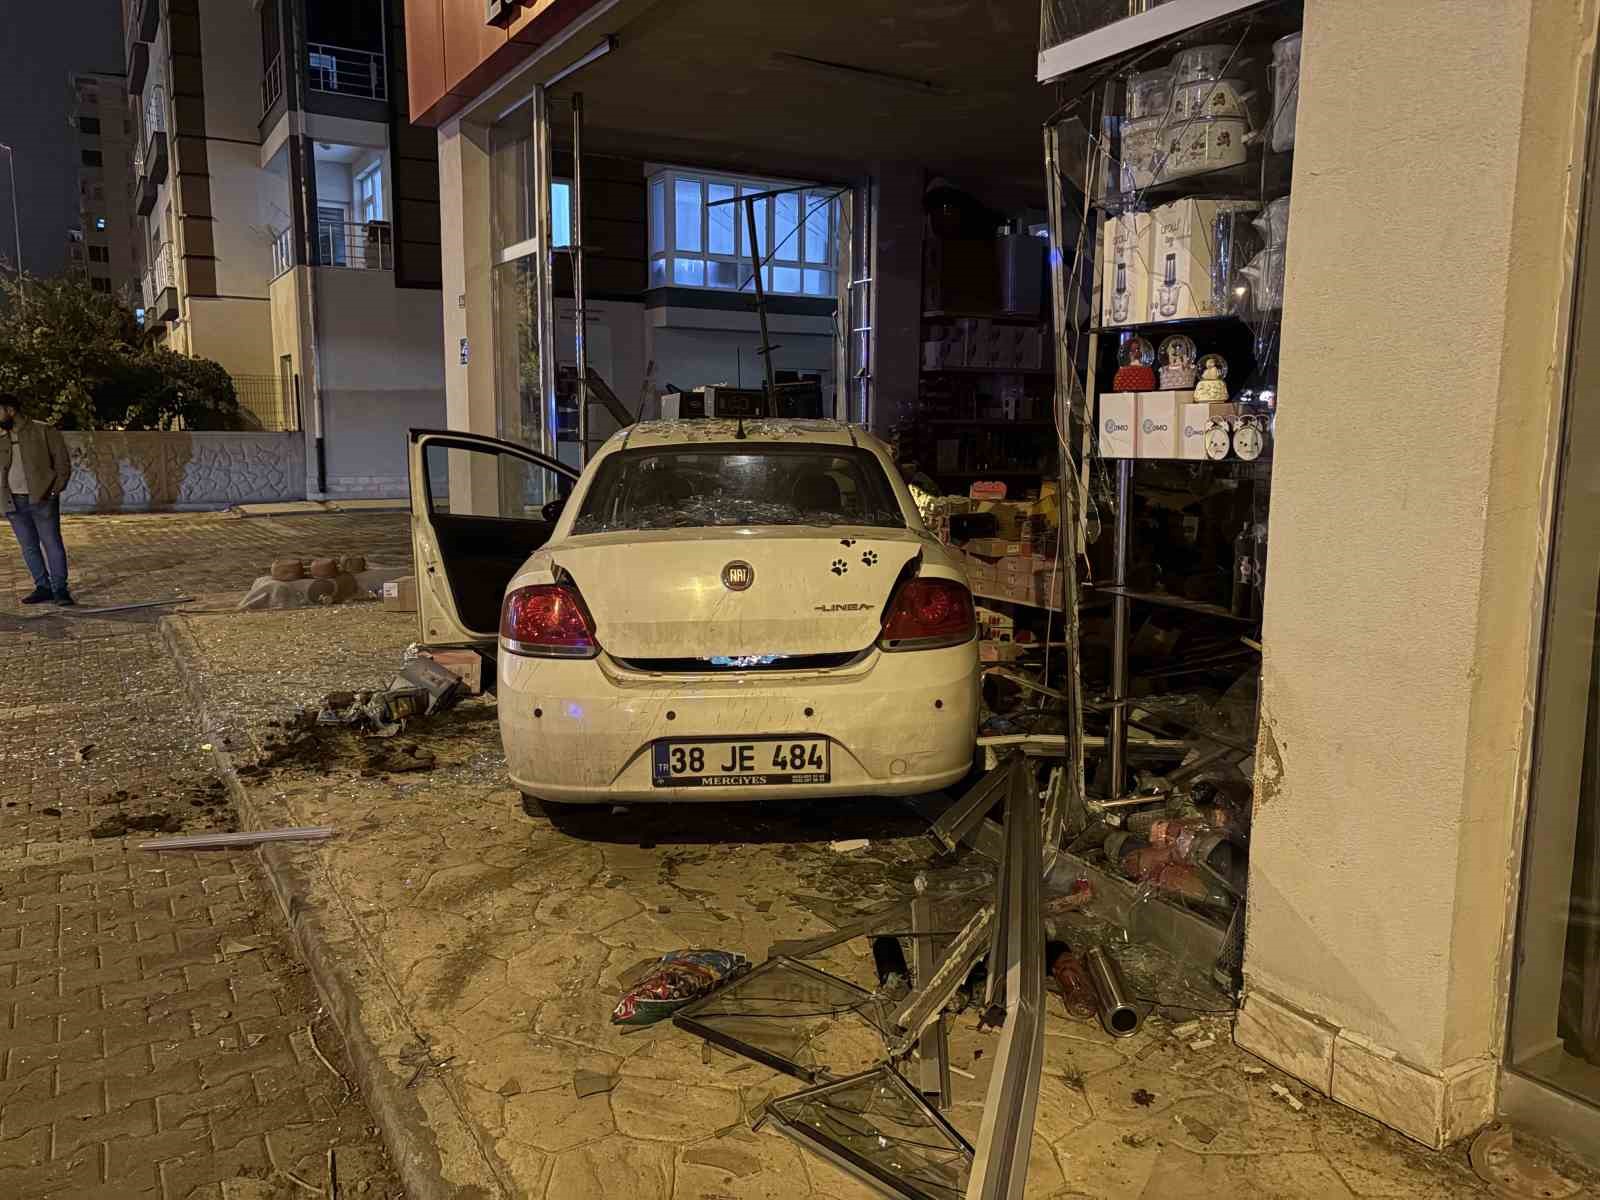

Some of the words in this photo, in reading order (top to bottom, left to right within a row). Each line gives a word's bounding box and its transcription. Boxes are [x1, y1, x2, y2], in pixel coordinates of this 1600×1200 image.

[729, 568, 747, 583] FIAT
[814, 603, 875, 613] LINEA
[672, 747, 705, 774] 38
[721, 745, 755, 772] JE
[772, 743, 823, 770] 484
[658, 763, 669, 773] TR
